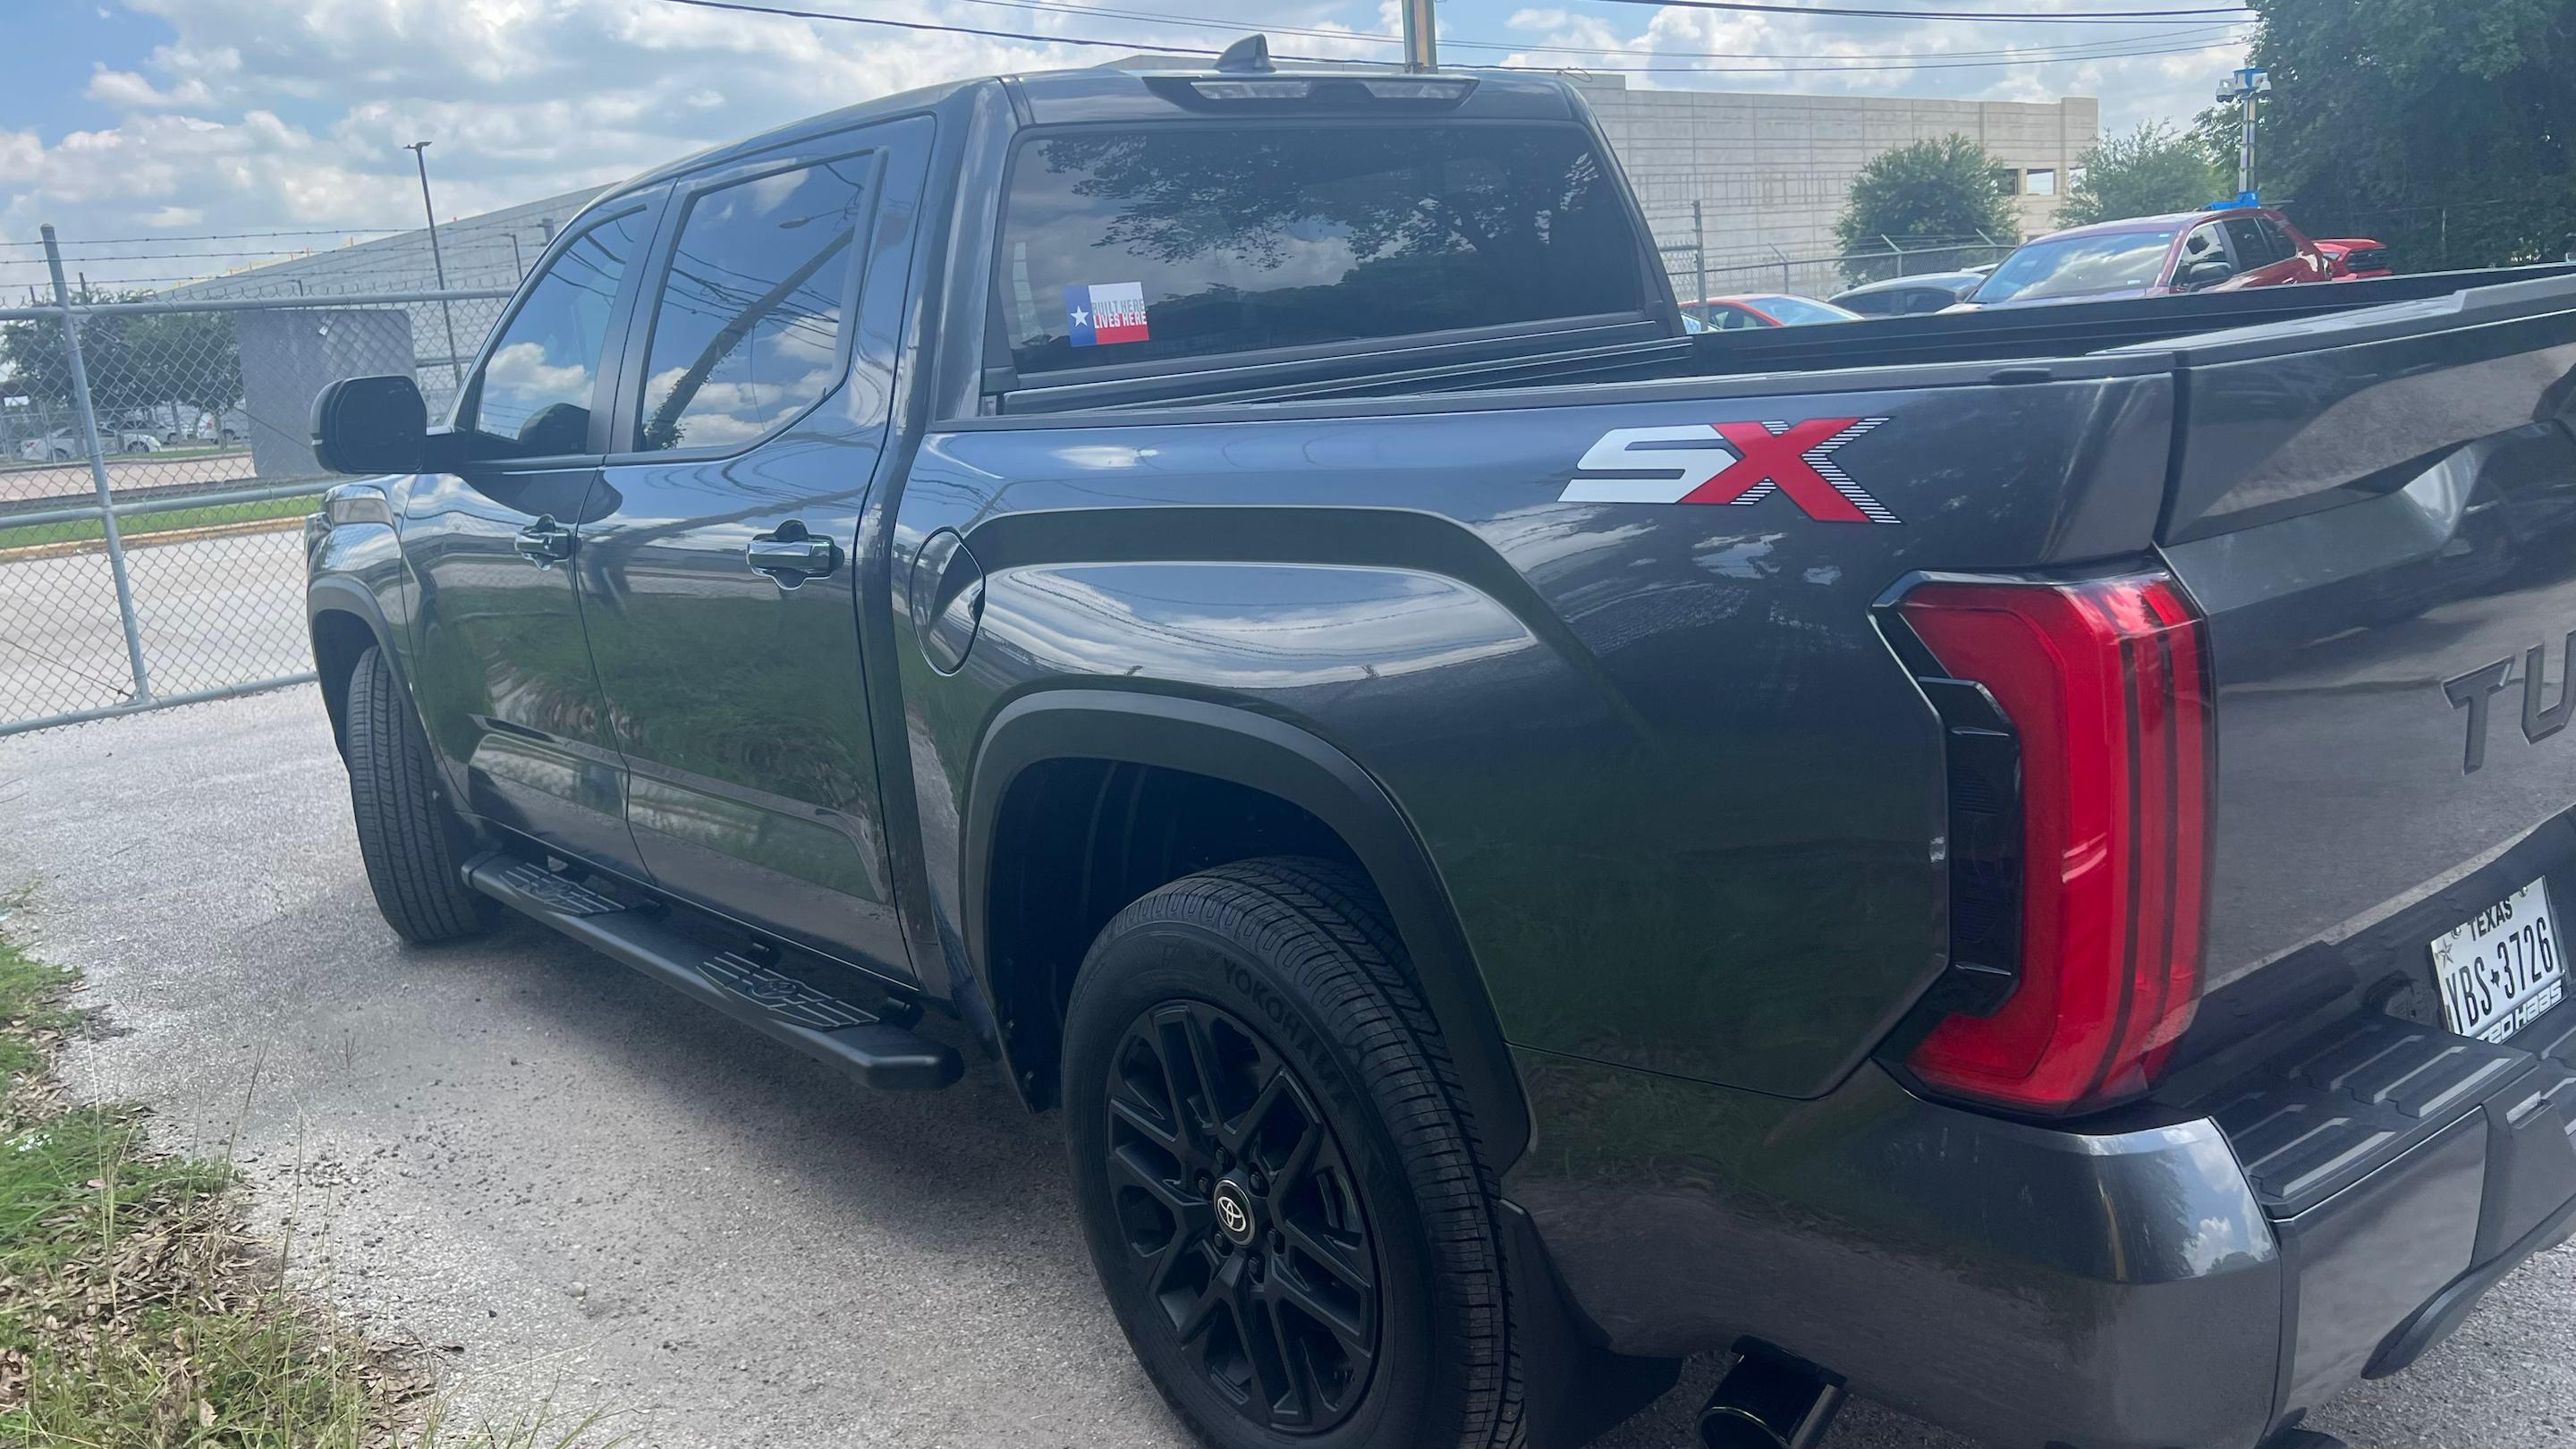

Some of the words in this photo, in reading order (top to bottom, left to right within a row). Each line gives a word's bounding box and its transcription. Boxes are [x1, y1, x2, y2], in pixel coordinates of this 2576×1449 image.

[1091, 301, 1118, 316] BUILT
[1121, 299, 1146, 313] HERE
[1093, 314, 1122, 329] LIVES
[1123, 311, 1148, 327] HERE
[1557, 416, 1902, 524] SX
[2442, 630, 2576, 775] TU
[2467, 899, 2513, 941] TEXAS
